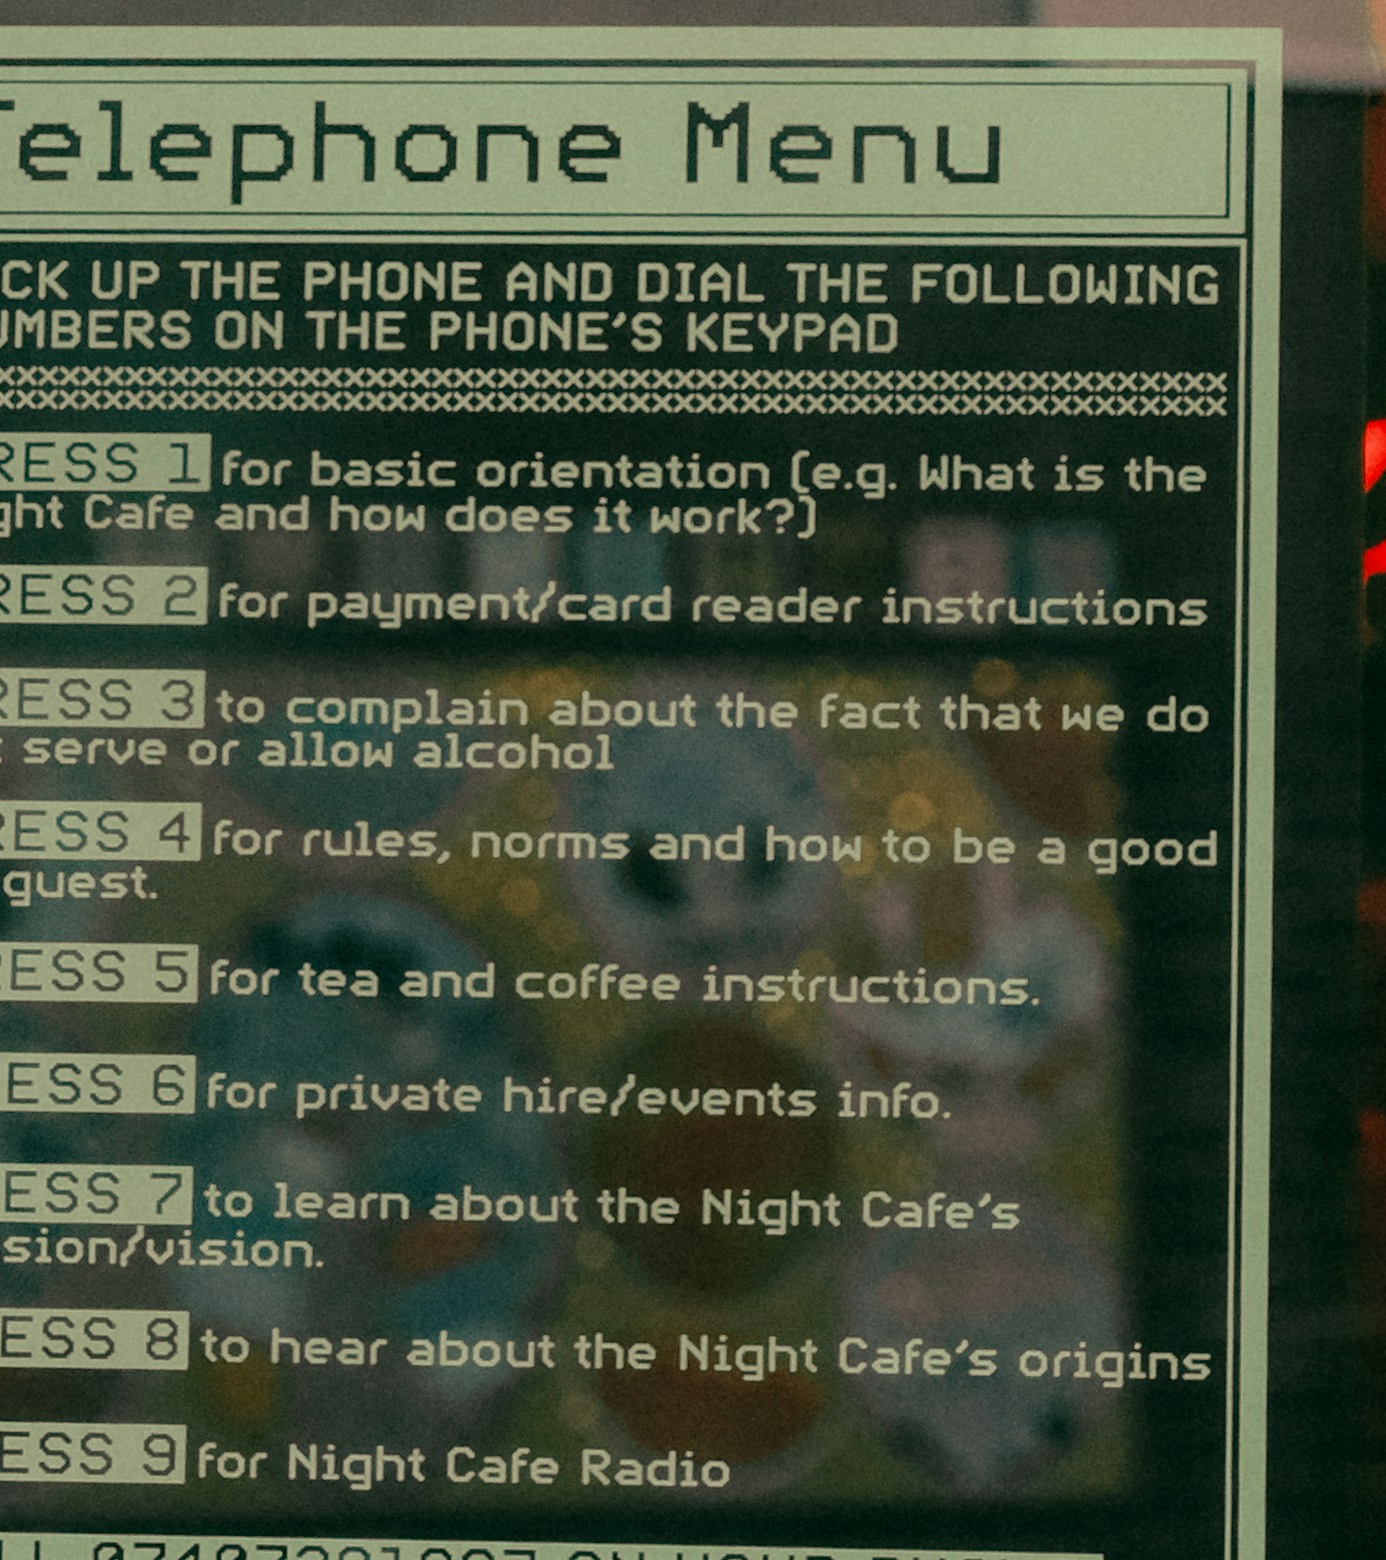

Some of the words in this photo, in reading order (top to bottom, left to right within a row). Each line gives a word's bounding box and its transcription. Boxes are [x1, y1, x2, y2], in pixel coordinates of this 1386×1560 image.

[685, 101, 1001, 185] Menu
[91, 259, 160, 301] UP
[179, 259, 281, 302] THE
[302, 260, 483, 302] PHONE
[505, 261, 614, 303] AND
[636, 261, 766, 303] DIAL
[785, 262, 889, 304] THE
[911, 263, 1220, 306] FOLLOWING
[214, 309, 284, 351] ON
[304, 310, 407, 352] THE
[429, 309, 664, 353] PHONE'S
[686, 311, 899, 355] KEYPAD
[168, 442, 201, 485] 1
[222, 449, 293, 487] for
[310, 449, 457, 488] basic
[476, 450, 771, 490] orientation
[789, 448, 897, 499] (e.g.
[919, 453, 1035, 492] What
[1053, 454, 1105, 492] is
[1123, 455, 1207, 493] the
[84, 492, 195, 532] Cafe
[214, 494, 311, 532] and
[329, 494, 427, 533] how
[444, 495, 574, 535] does
[592, 496, 633, 535] it
[648, 495, 817, 540] work?)
[164, 574, 198, 618] 2
[218, 581, 290, 619] for
[307, 579, 673, 630] payment/card
[692, 586, 863, 624] reader
[881, 586, 1209, 627] instructions
[160, 678, 195, 723] 3
[214, 689, 266, 724] to
[286, 687, 529, 734] complain
[548, 689, 697, 728] about
[715, 691, 799, 729] the
[819, 692, 922, 731] fact
[937, 693, 1043, 732] that
[1061, 702, 1126, 734] we
[1146, 694, 1210, 734] do
[22, 736, 168, 766] serve
[187, 738, 241, 767] or
[257, 730, 394, 769] allow
[412, 732, 615, 771] alcohol
[158, 811, 191, 854] 4
[213, 819, 283, 856] for
[302, 820, 451, 864] rules,
[471, 830, 631, 861] norms
[648, 823, 746, 863] and
[765, 823, 862, 864] how
[882, 829, 931, 864] to
[953, 826, 1017, 865] be
[1037, 836, 1066, 866] a
[1086, 828, 1219, 877] good
[2, 865, 158, 909] guest.
[154, 949, 189, 994] 5
[209, 957, 281, 997] for
[297, 961, 380, 998] tea
[398, 961, 496, 1000] and
[514, 962, 682, 1001] coffee
[702, 964, 1040, 1007] instructions.
[152, 1062, 186, 1108] 6
[207, 1071, 278, 1110] for
[295, 1073, 483, 1121] private
[503, 1072, 818, 1118] hire/events
[837, 1079, 952, 1121] info.
[150, 1171, 183, 1216] 7
[203, 1182, 254, 1219] to
[273, 1180, 411, 1221] learn
[428, 1184, 580, 1224] about
[596, 1186, 681, 1225] the
[701, 1188, 842, 1236] Night
[861, 1190, 1021, 1231] Cafe's
[145, 1316, 179, 1362] 8
[199, 1327, 250, 1364] to
[270, 1325, 389, 1366] hear
[405, 1329, 556, 1370] about
[572, 1331, 657, 1371] the
[678, 1333, 819, 1383] Night
[838, 1336, 998, 1377] Cafe's
[1018, 1340, 1213, 1391] origins
[142, 1432, 177, 1477] 9
[197, 1440, 269, 1480] for
[287, 1442, 426, 1492] Night
[445, 1445, 560, 1486] Cafe
[581, 1448, 731, 1489] Radio
